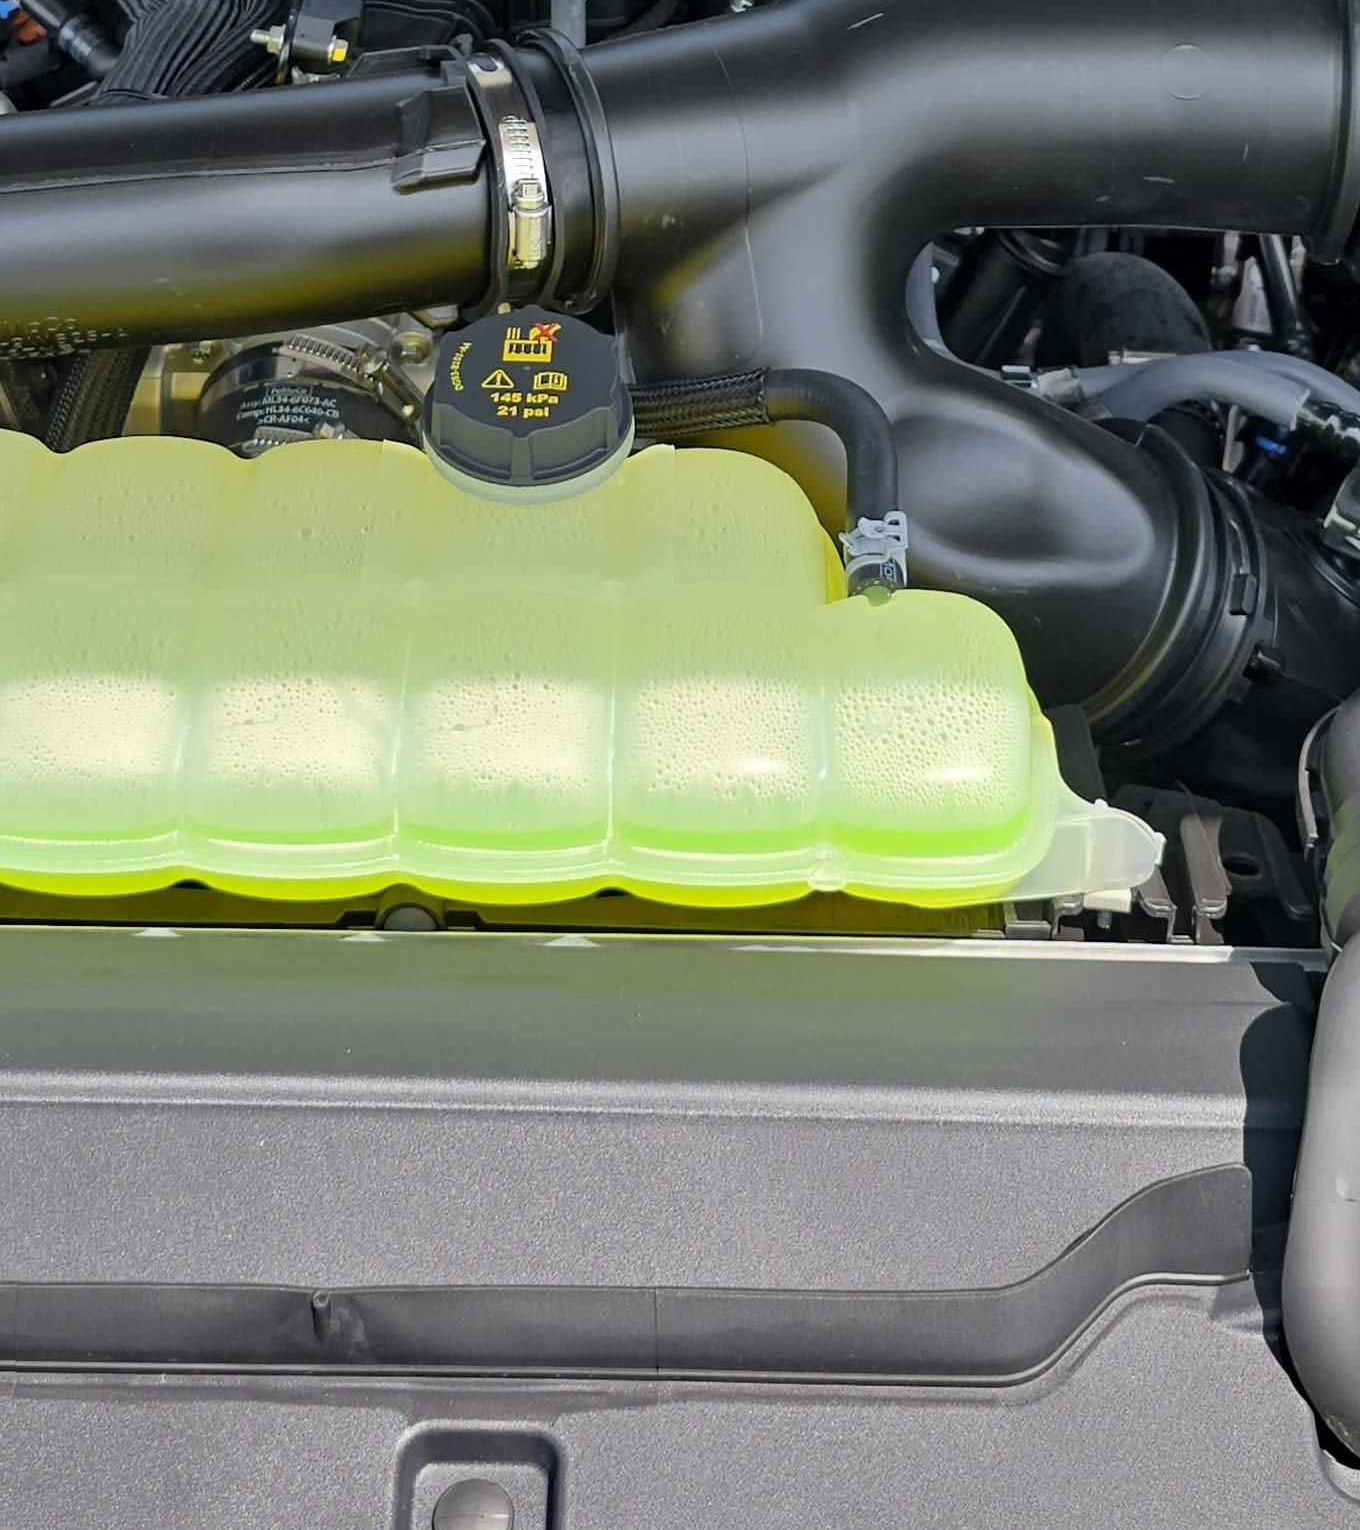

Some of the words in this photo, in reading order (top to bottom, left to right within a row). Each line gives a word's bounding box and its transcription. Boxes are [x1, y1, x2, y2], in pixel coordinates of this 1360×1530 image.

[490, 392, 522, 403] 145
[526, 392, 559, 405] kPa
[496, 405, 518, 417] 21
[523, 406, 550, 419] psi
